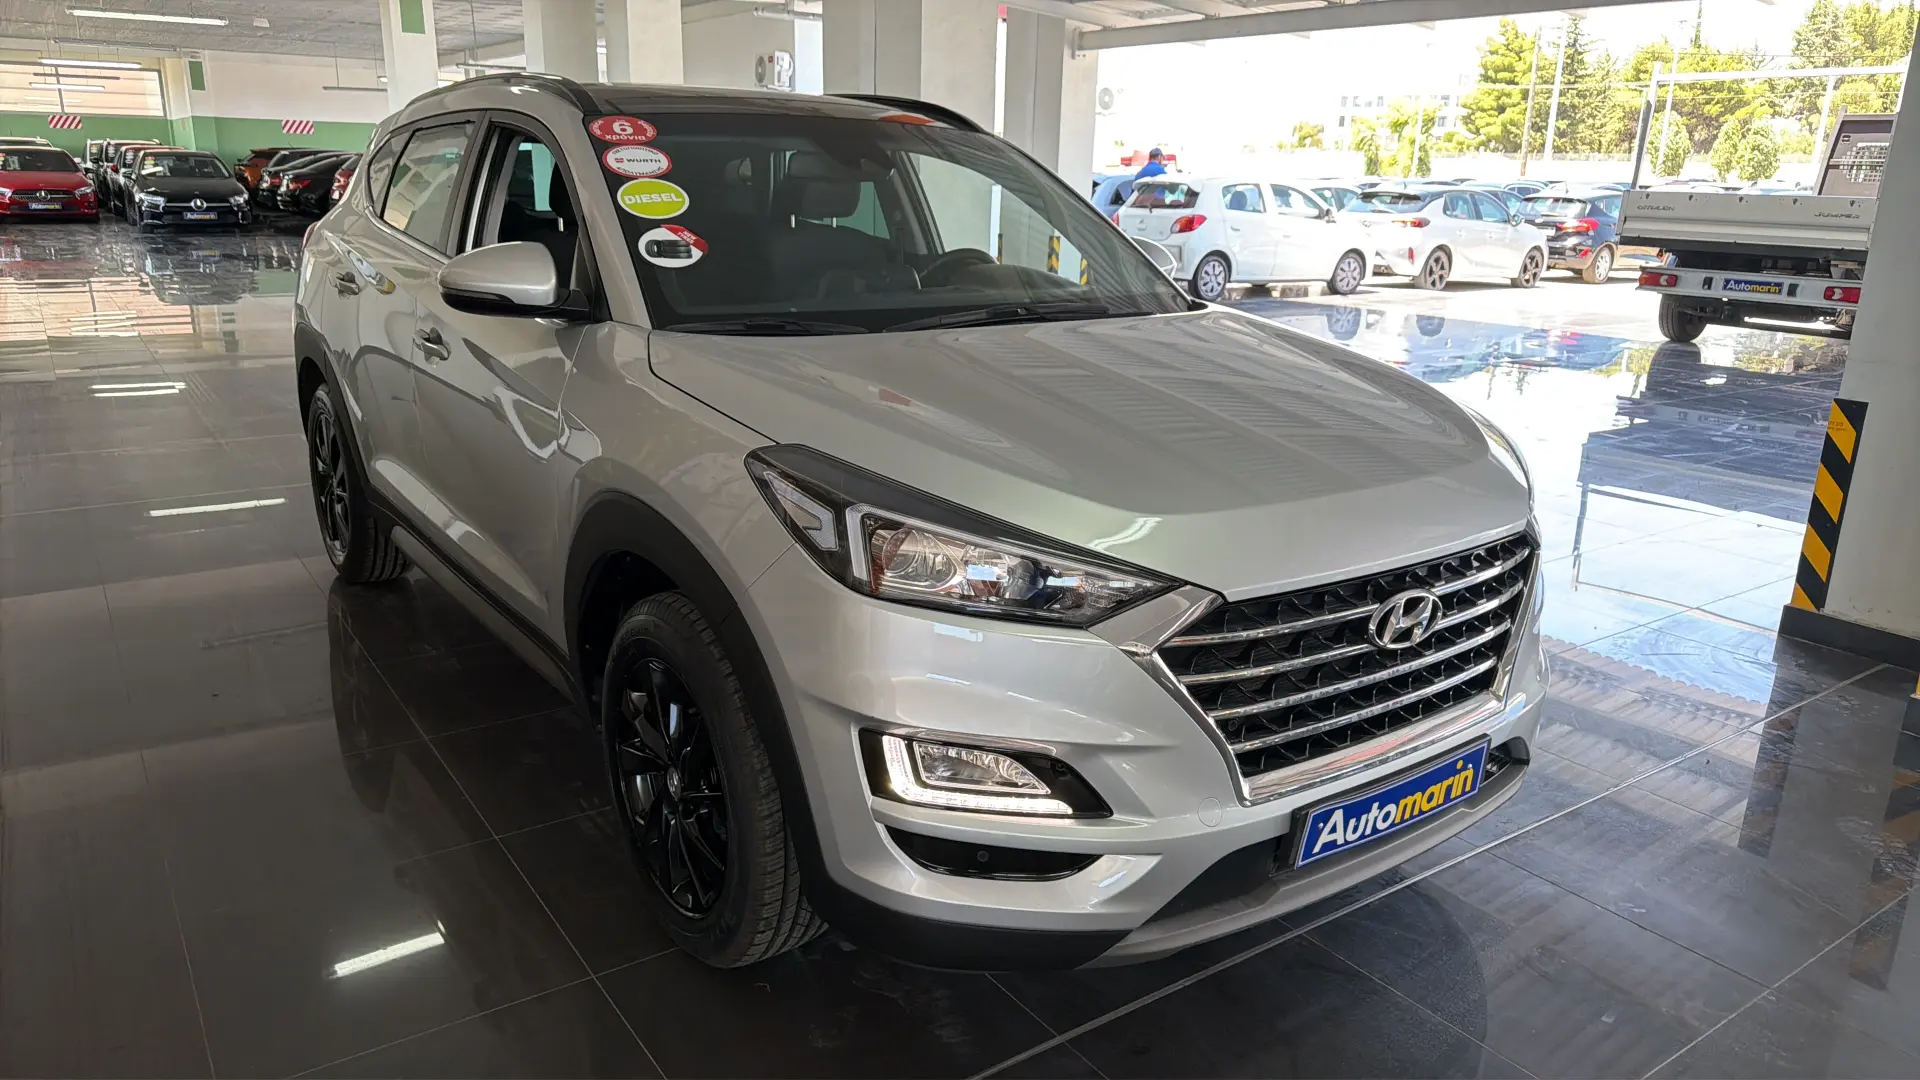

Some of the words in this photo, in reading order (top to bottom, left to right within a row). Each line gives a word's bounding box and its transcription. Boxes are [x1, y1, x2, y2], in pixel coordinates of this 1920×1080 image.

[624, 193, 682, 205] DIESEL
[1726, 280, 1779, 293] Automarin
[1312, 759, 1474, 854] Automarin
